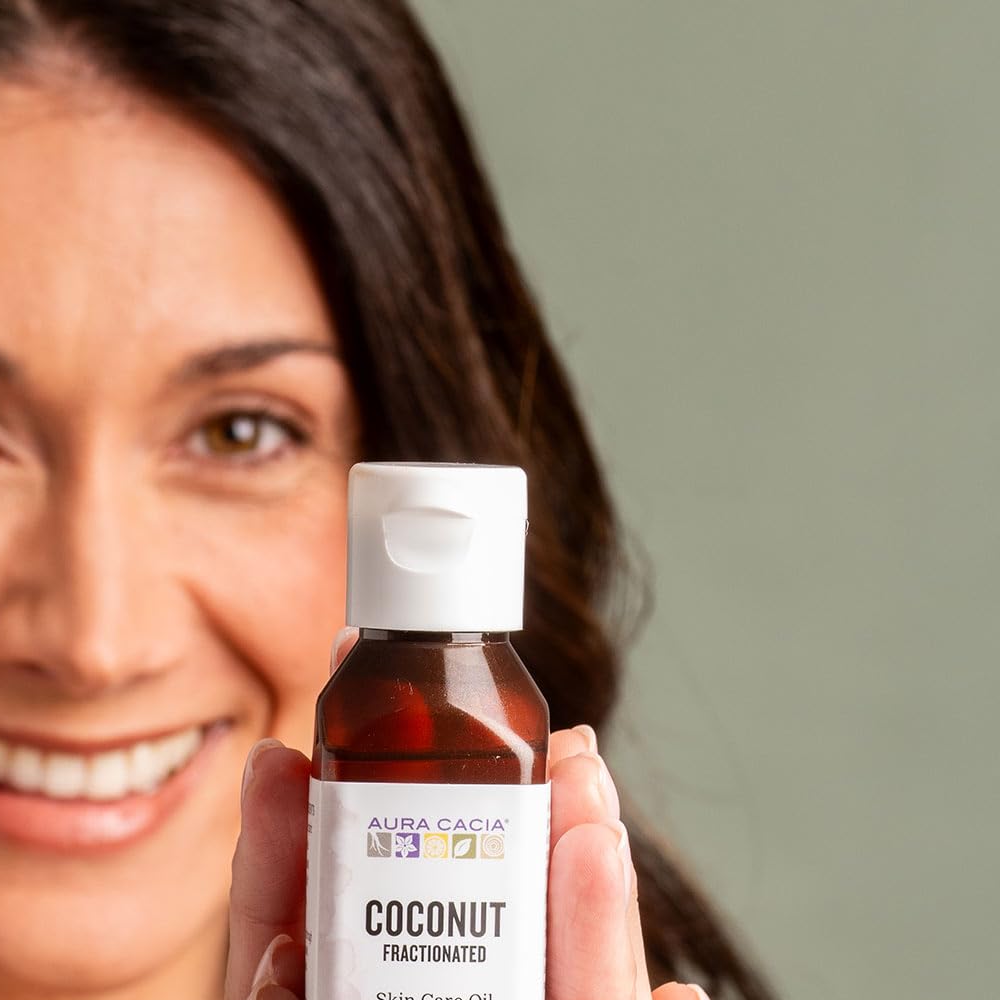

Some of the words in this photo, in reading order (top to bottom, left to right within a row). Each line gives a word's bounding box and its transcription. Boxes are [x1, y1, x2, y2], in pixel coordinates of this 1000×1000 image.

[368, 817, 430, 830] AURA
[365, 899, 506, 938] COCONUT
[383, 944, 487, 963] FRACTIONATED
